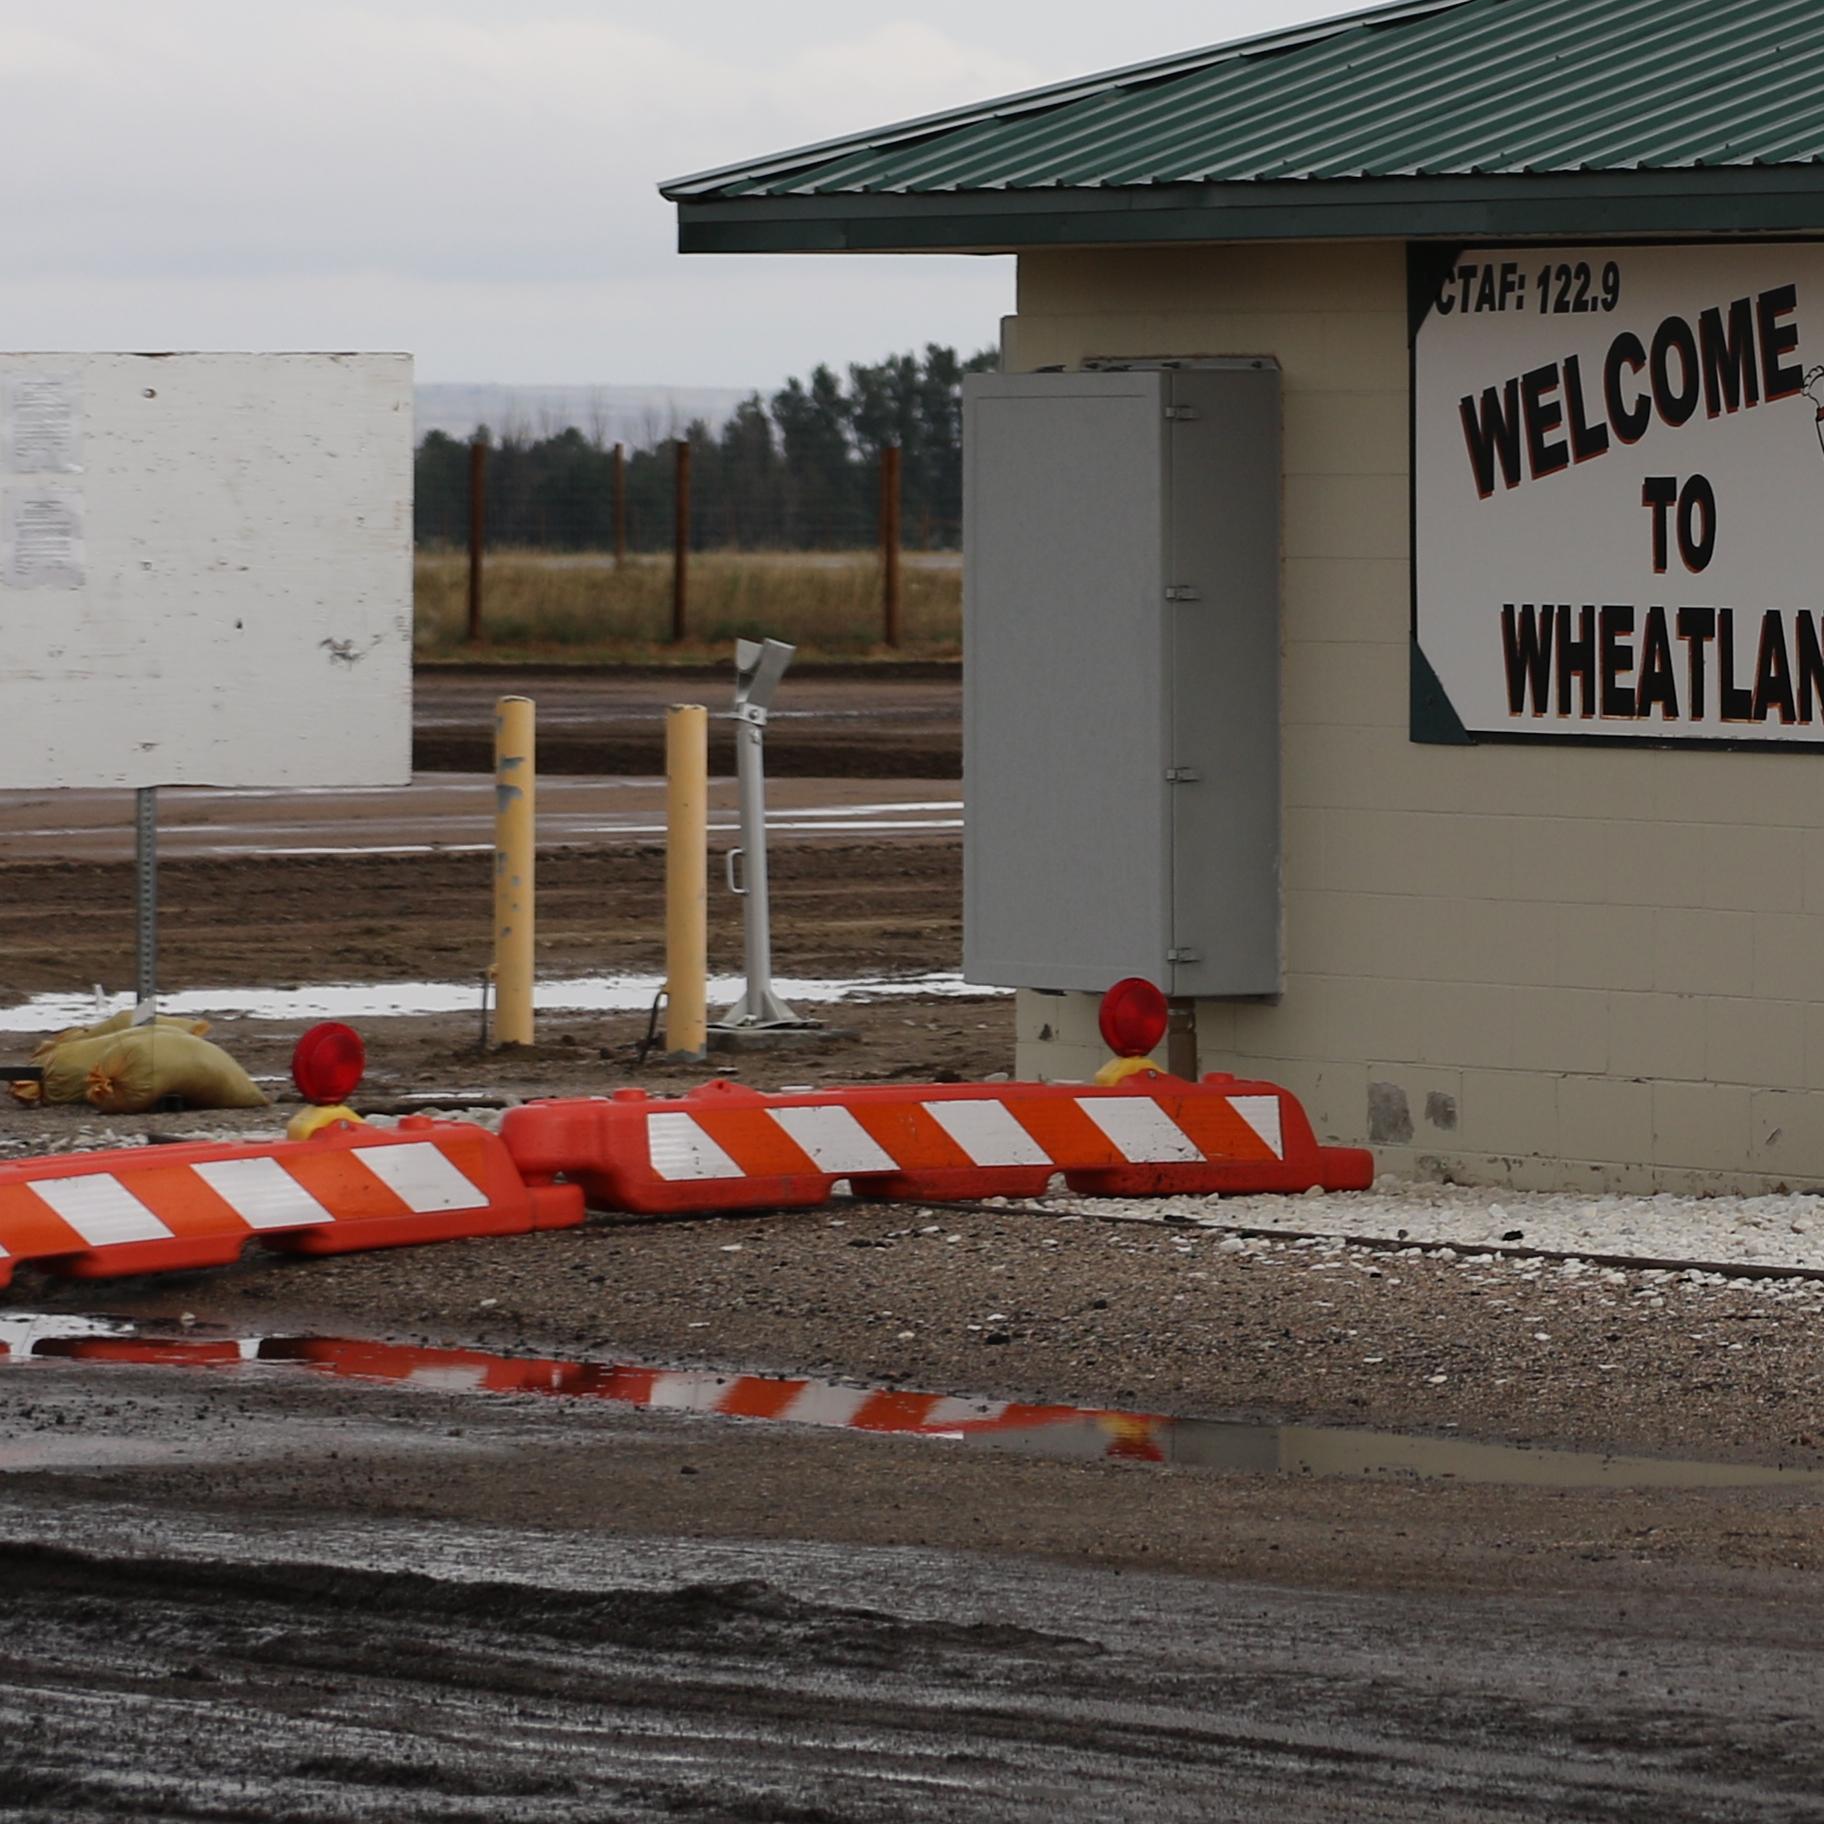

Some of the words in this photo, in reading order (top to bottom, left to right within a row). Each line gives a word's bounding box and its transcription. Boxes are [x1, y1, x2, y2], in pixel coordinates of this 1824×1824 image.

[1435, 262, 1525, 315] CTAF:
[1537, 261, 1620, 314] 122.9
[1458, 283, 1804, 500] WELCOME
[1642, 473, 1716, 574] TO
